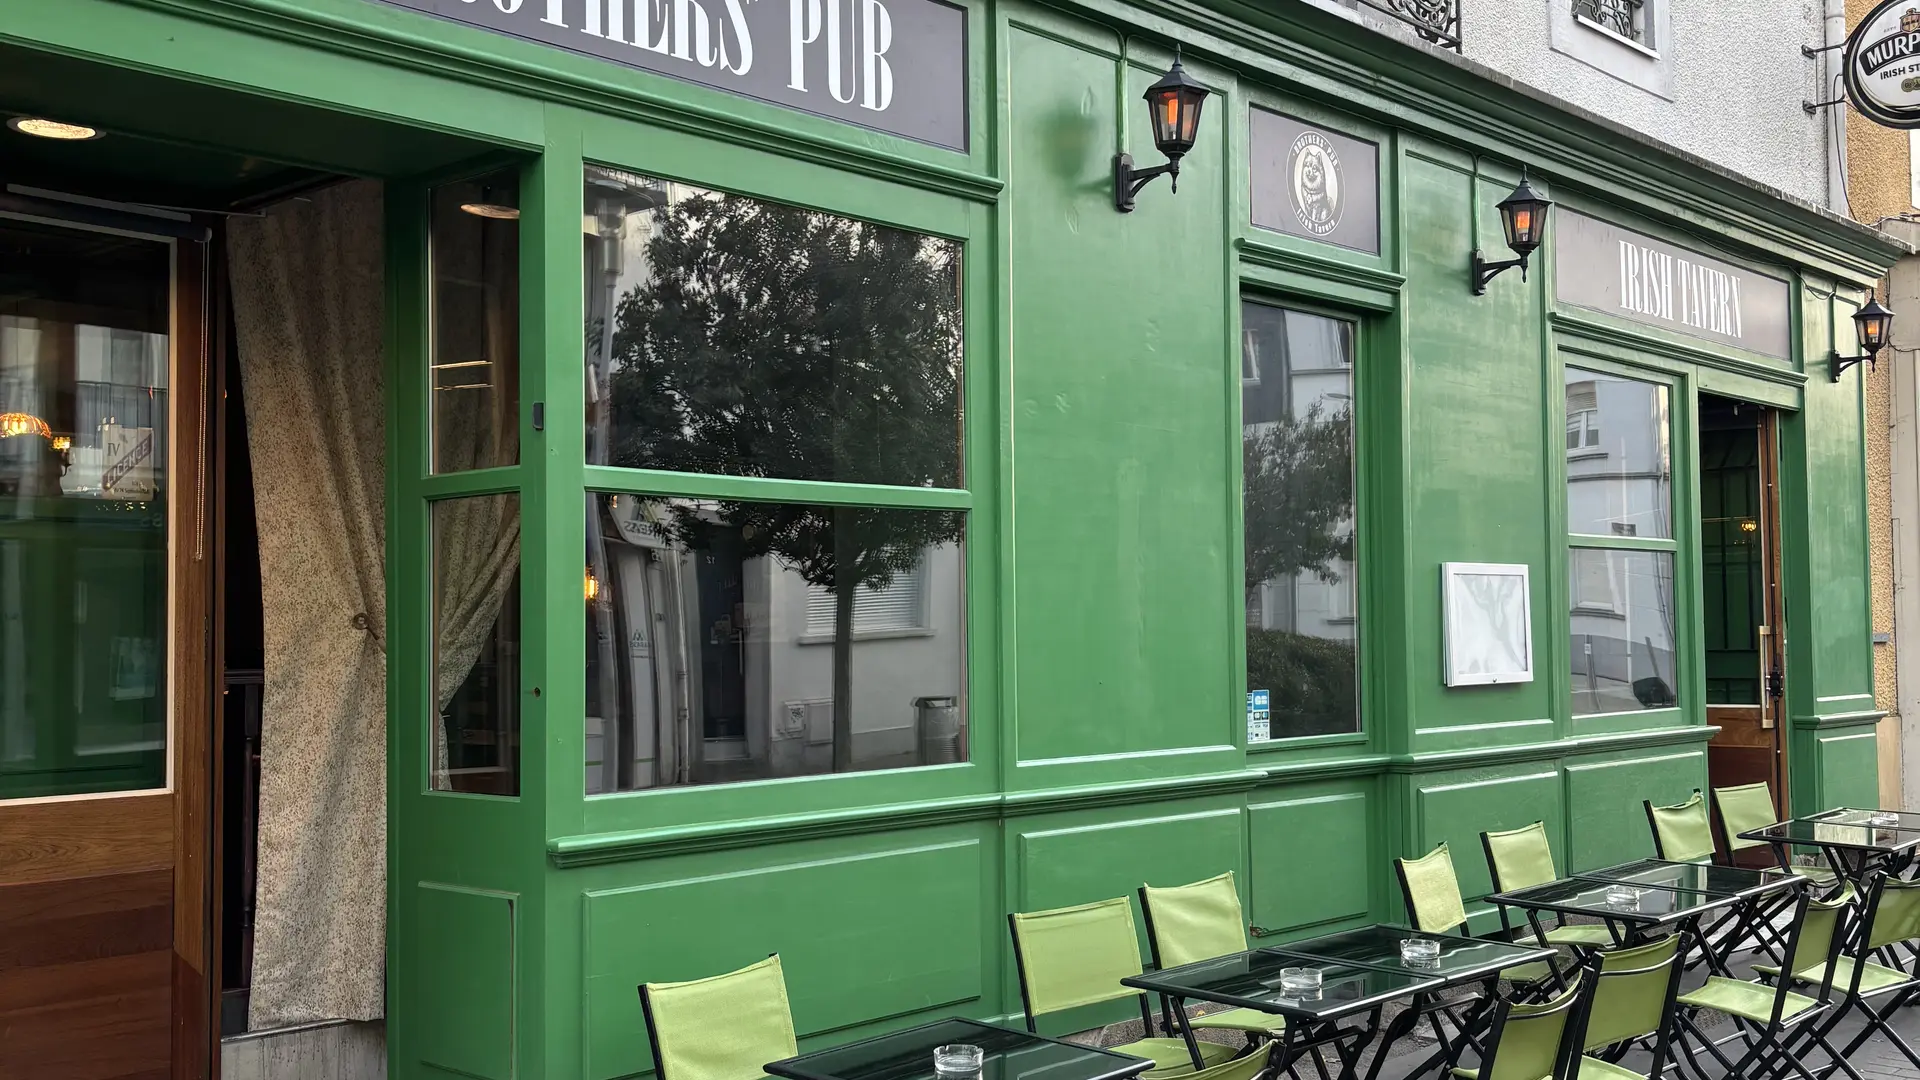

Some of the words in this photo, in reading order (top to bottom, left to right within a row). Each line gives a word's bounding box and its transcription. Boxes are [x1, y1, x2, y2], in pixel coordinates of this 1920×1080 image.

[787, 0, 893, 111] PUB
[1880, 66, 1906, 80] IRISH
[1326, 147, 1338, 167] PUB
[1315, 219, 1336, 234] Tavern
[1618, 240, 1674, 321] IRISH
[1677, 258, 1742, 339] TAVERN
[107, 442, 121, 456] IV
[107, 440, 149, 485] LICENCE
